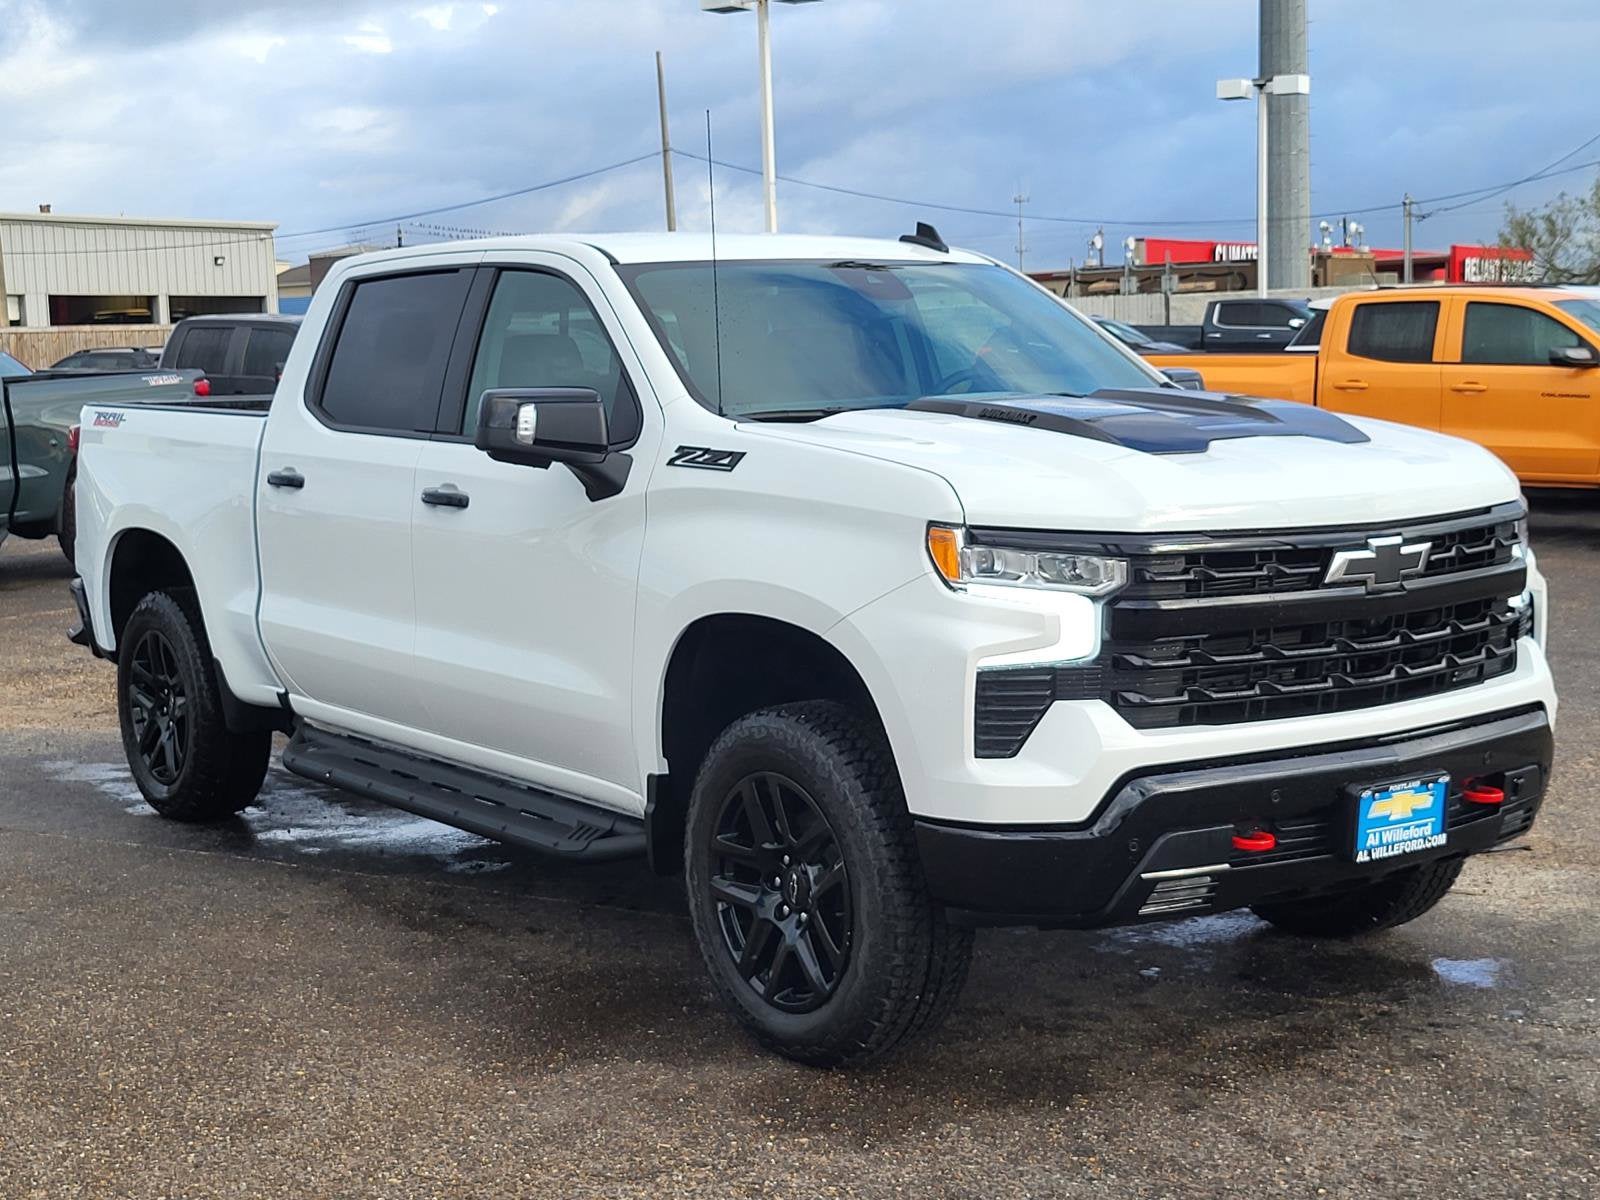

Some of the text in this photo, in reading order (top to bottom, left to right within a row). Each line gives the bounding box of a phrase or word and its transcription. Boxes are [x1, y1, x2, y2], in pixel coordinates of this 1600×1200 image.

[94, 410, 127, 422] TRAIL
[666, 444, 747, 472] Z71
[1356, 833, 1448, 863] AL WILLEFORD.COM
[1366, 822, 1432, 848] Al Willeford
